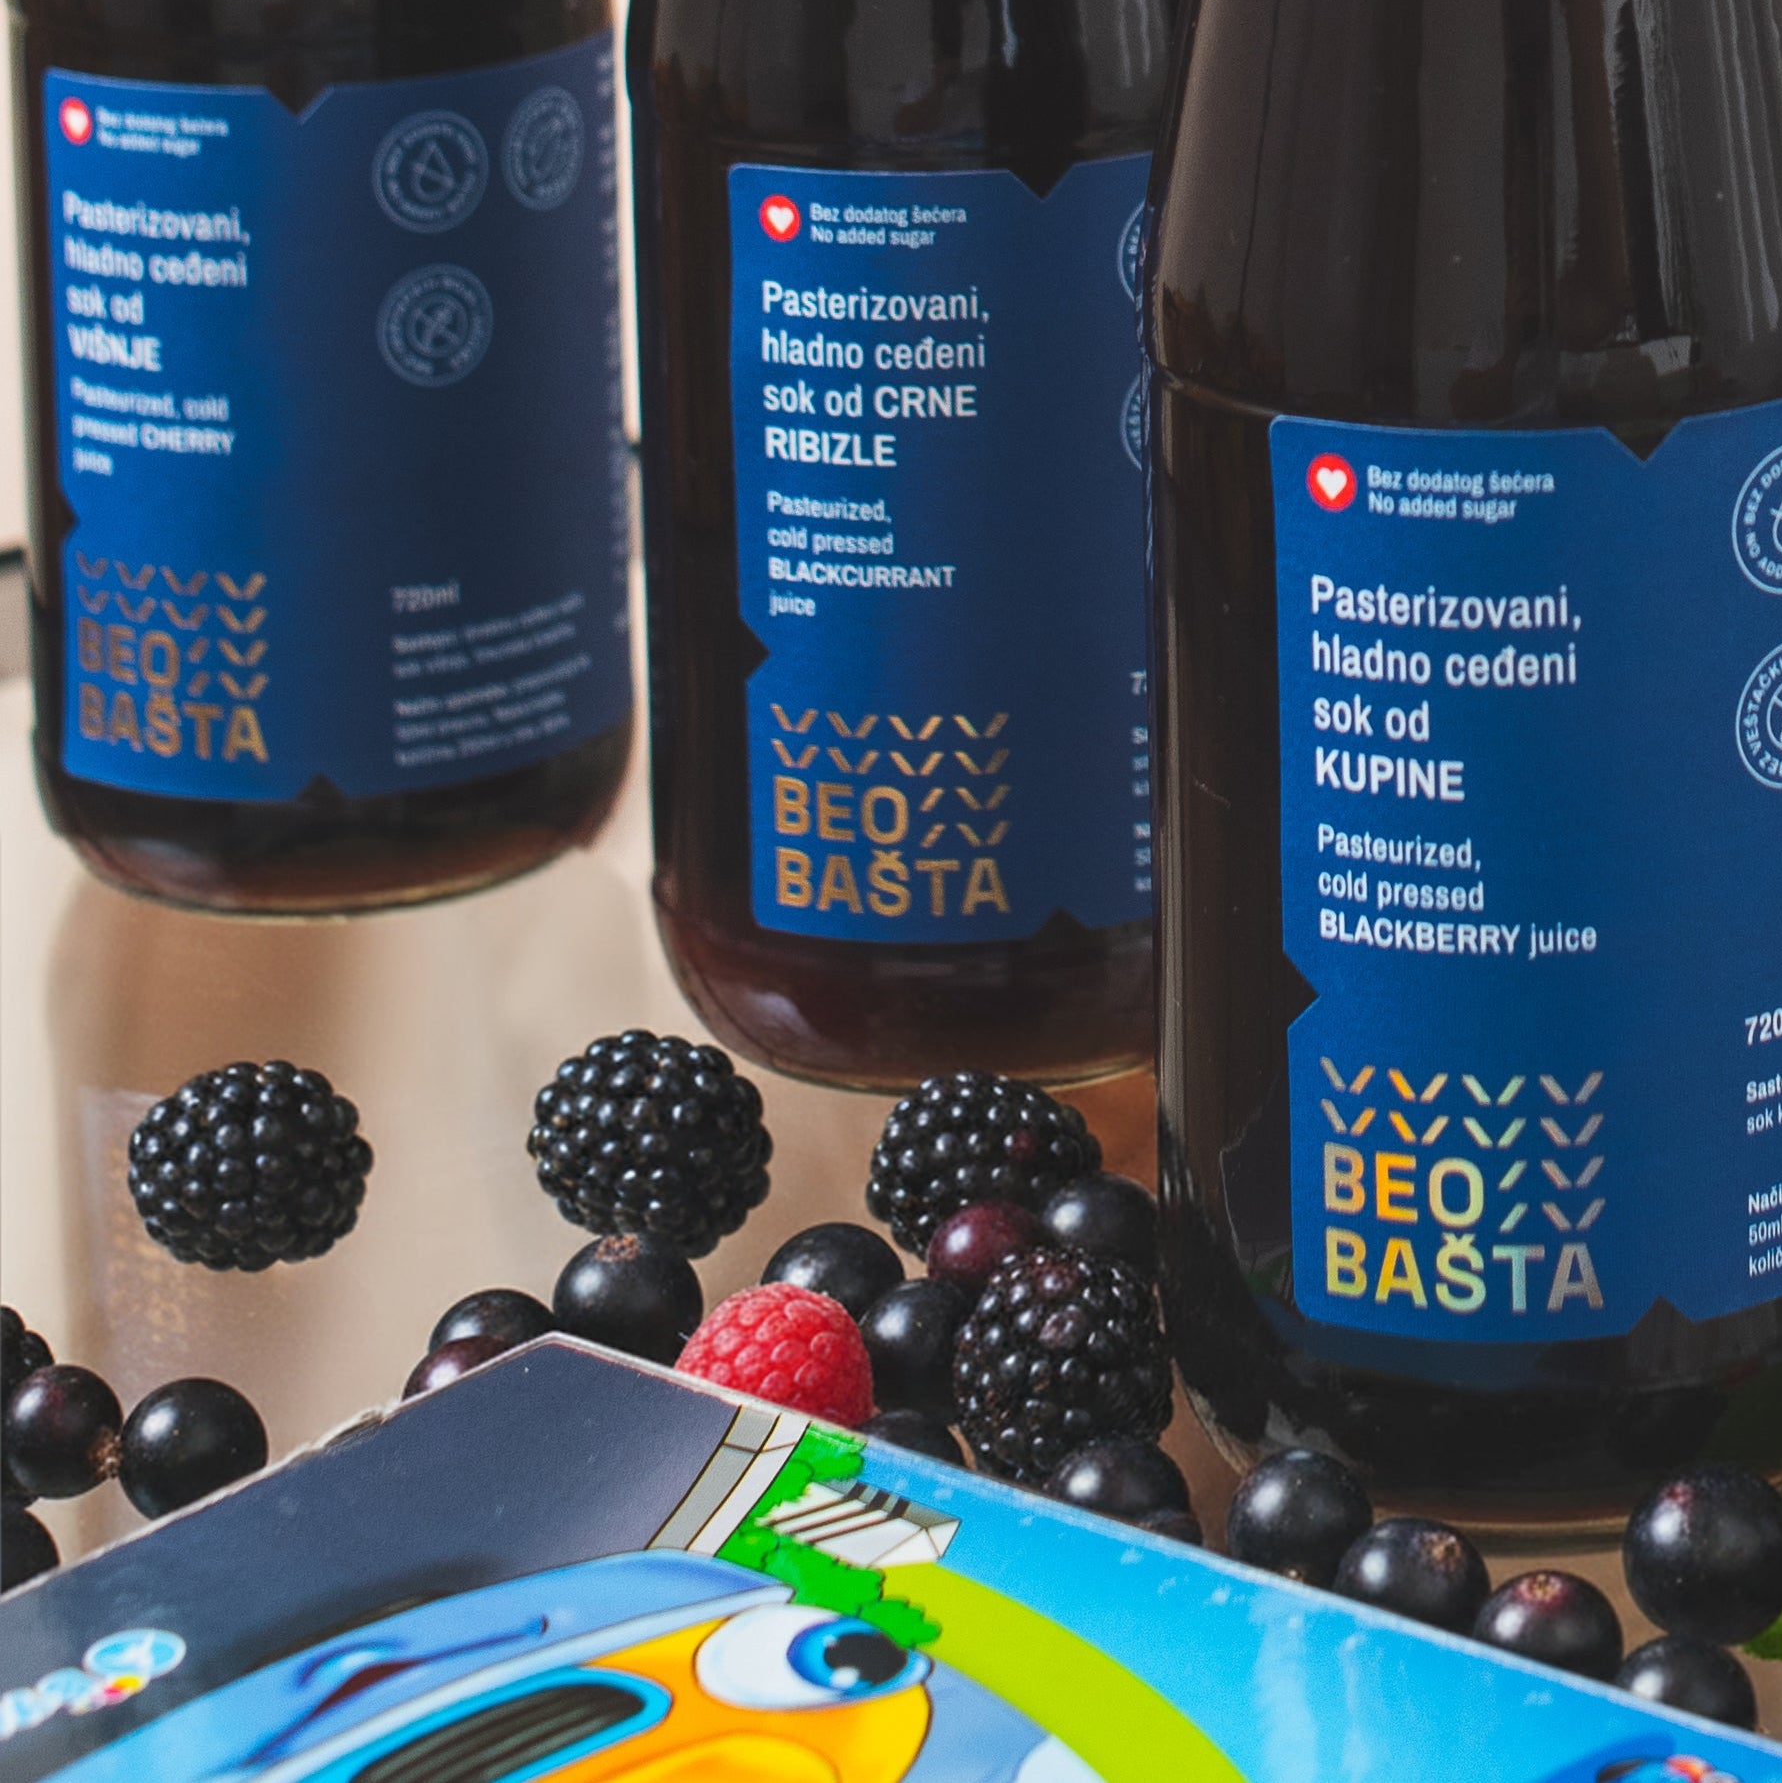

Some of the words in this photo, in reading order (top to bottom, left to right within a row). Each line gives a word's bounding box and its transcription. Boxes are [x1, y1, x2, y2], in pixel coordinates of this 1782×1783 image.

[62, 190, 250, 245] Pasterizovani,
[809, 201, 839, 222] Bez
[843, 205, 908, 226] dodatog
[64, 235, 143, 281] hladno
[810, 226, 833, 244] No
[837, 227, 886, 246] added
[889, 230, 936, 249] sugar
[66, 285, 107, 319] sok
[110, 290, 143, 325] od
[762, 280, 990, 324] Pasterizovani,
[67, 323, 162, 371] VIŠNJE
[761, 328, 863, 370] hladno
[875, 334, 986, 370] ceđeni
[763, 380, 815, 416] sok
[825, 384, 862, 418] od
[874, 384, 977, 419] CRNE
[140, 422, 235, 455] CHERRY
[765, 426, 897, 467] RIBIZLE
[1367, 464, 1402, 490] Bez
[1407, 469, 1484, 498] dodatog
[767, 491, 892, 524] Pasteurized,
[1367, 491, 1394, 516] No
[1399, 494, 1457, 519] added
[1462, 498, 1518, 524] sugar
[1743, 486, 1764, 526] BEZ
[767, 527, 806, 553] cold
[812, 531, 893, 556] pressed
[1745, 530, 1761, 558] NO
[768, 556, 955, 589] BLACKCURRANT
[769, 591, 816, 617] juice
[1311, 573, 1583, 632] Pasterizovani,
[77, 616, 180, 687] BEO
[1312, 629, 1432, 684] hladno
[1445, 642, 1577, 687] ceđeni
[79, 682, 269, 763] BAŠTA
[1313, 693, 1373, 737] sok
[1385, 700, 1430, 742] od
[1315, 746, 1465, 802] KUPINE
[774, 774, 909, 845] BEO
[1318, 822, 1482, 874] Pasteurized,
[776, 846, 1012, 917] BAŠTA
[1318, 869, 1368, 903] cold
[1377, 880, 1485, 912] pressed
[1320, 908, 1521, 955] BLACKBERRY
[1528, 921, 1598, 961] juice
[1746, 1107, 1774, 1136] sok
[1324, 1141, 1485, 1229] BEO
[1325, 1226, 1604, 1314] BAŠTA
